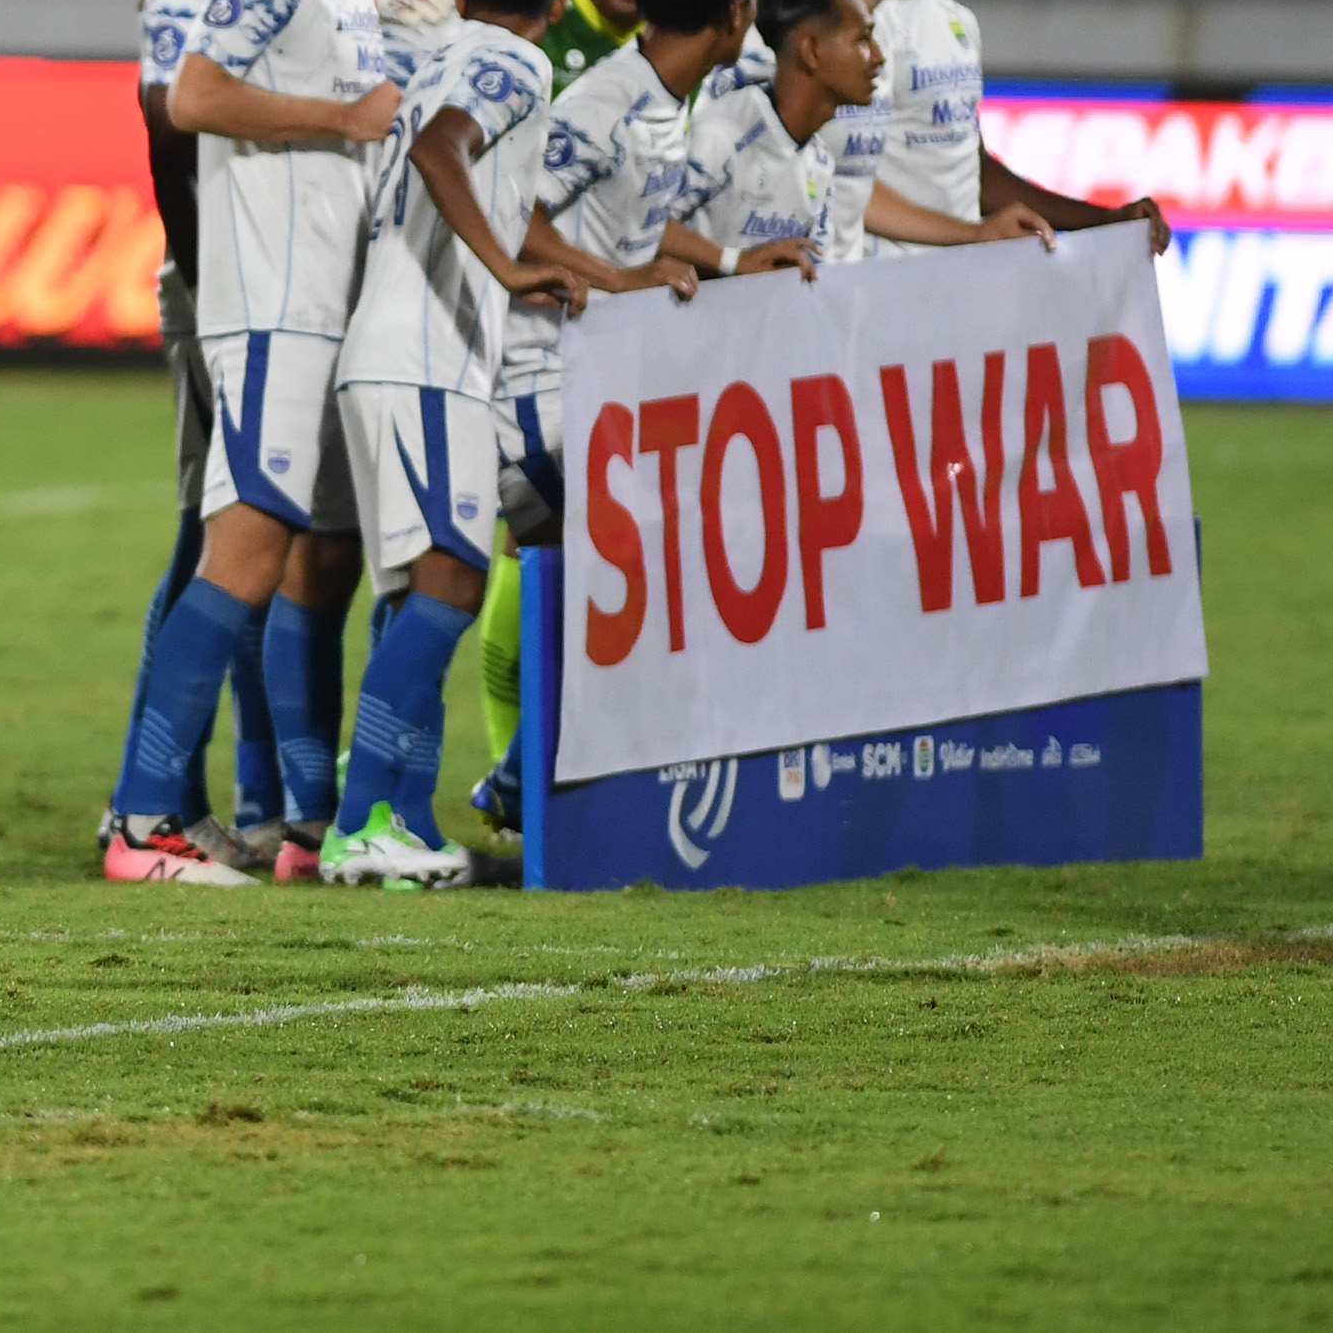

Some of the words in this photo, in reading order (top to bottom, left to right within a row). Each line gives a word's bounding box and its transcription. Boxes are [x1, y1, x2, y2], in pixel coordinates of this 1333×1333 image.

[585, 372, 864, 667] STOP
[880, 333, 1172, 614] WAR
[862, 742, 901, 778] SCM
